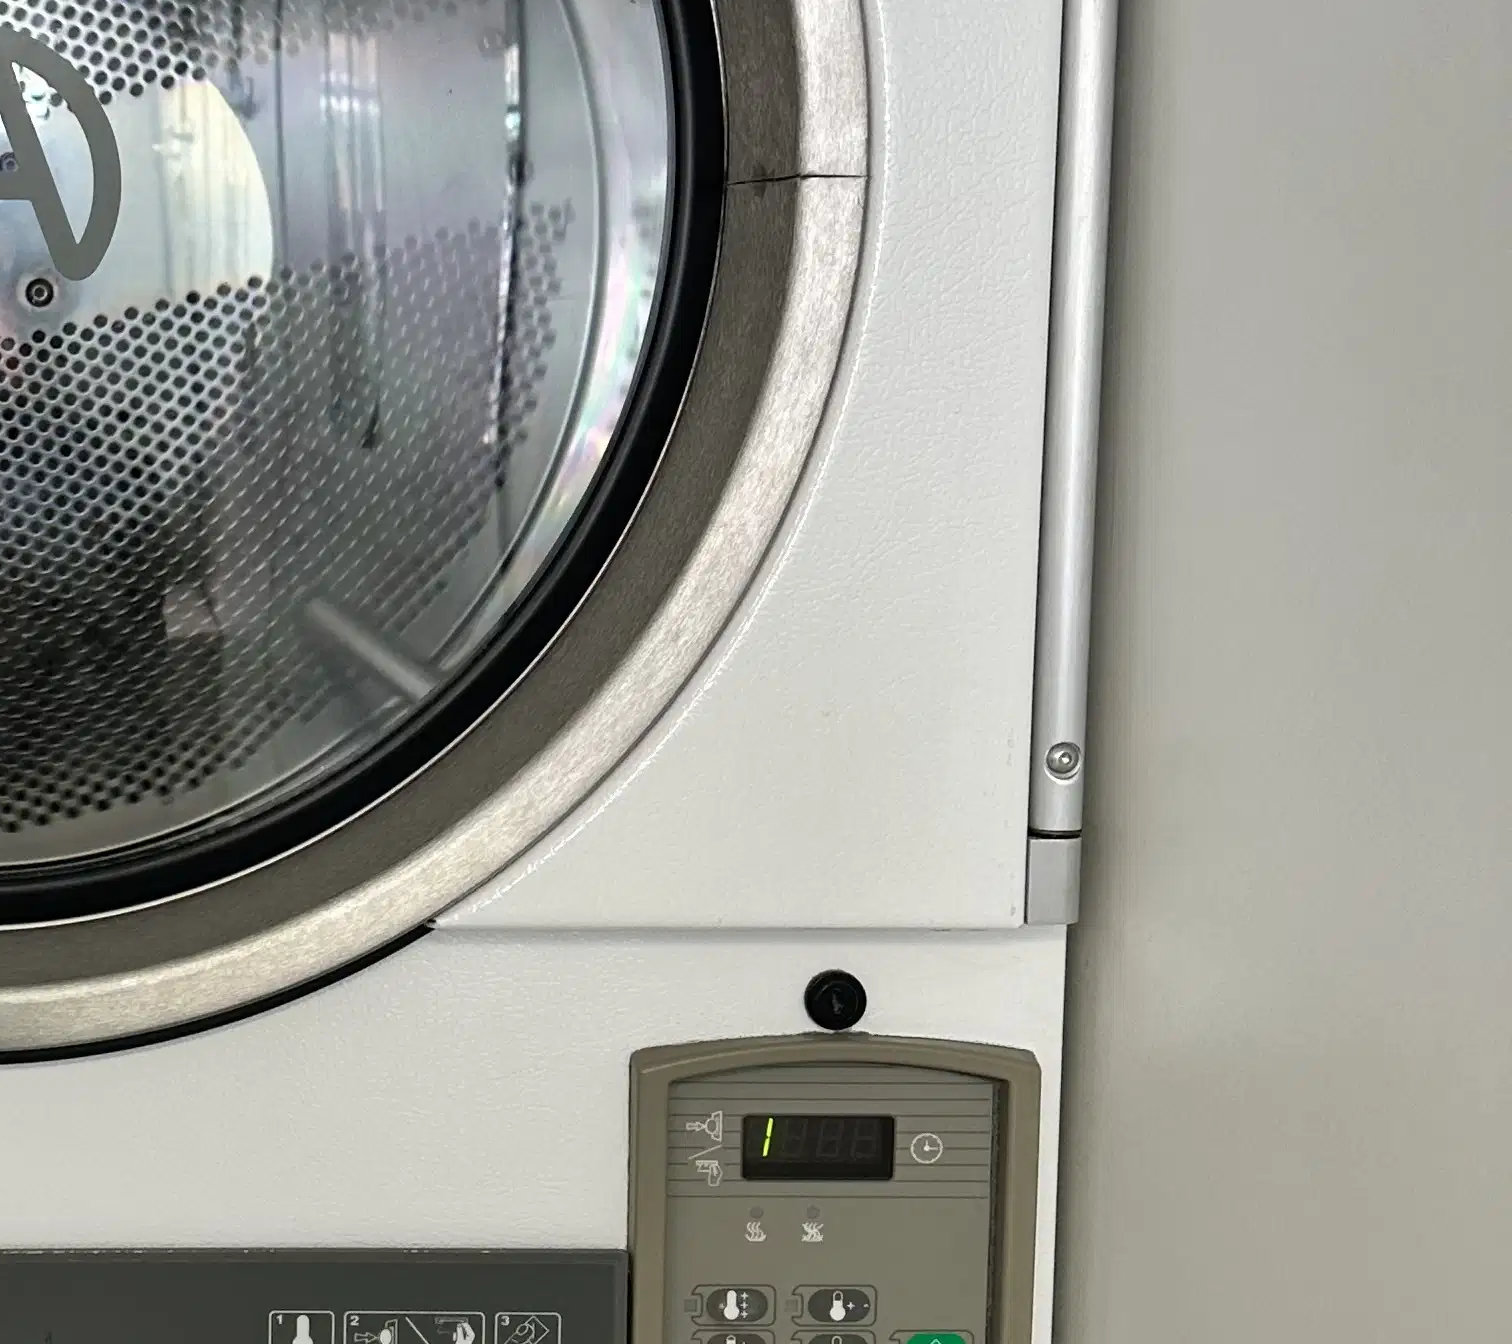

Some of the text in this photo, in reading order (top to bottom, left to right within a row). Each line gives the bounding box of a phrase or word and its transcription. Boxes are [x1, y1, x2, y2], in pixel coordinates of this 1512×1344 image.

[276, 1314, 510, 1326] 1 2 3
